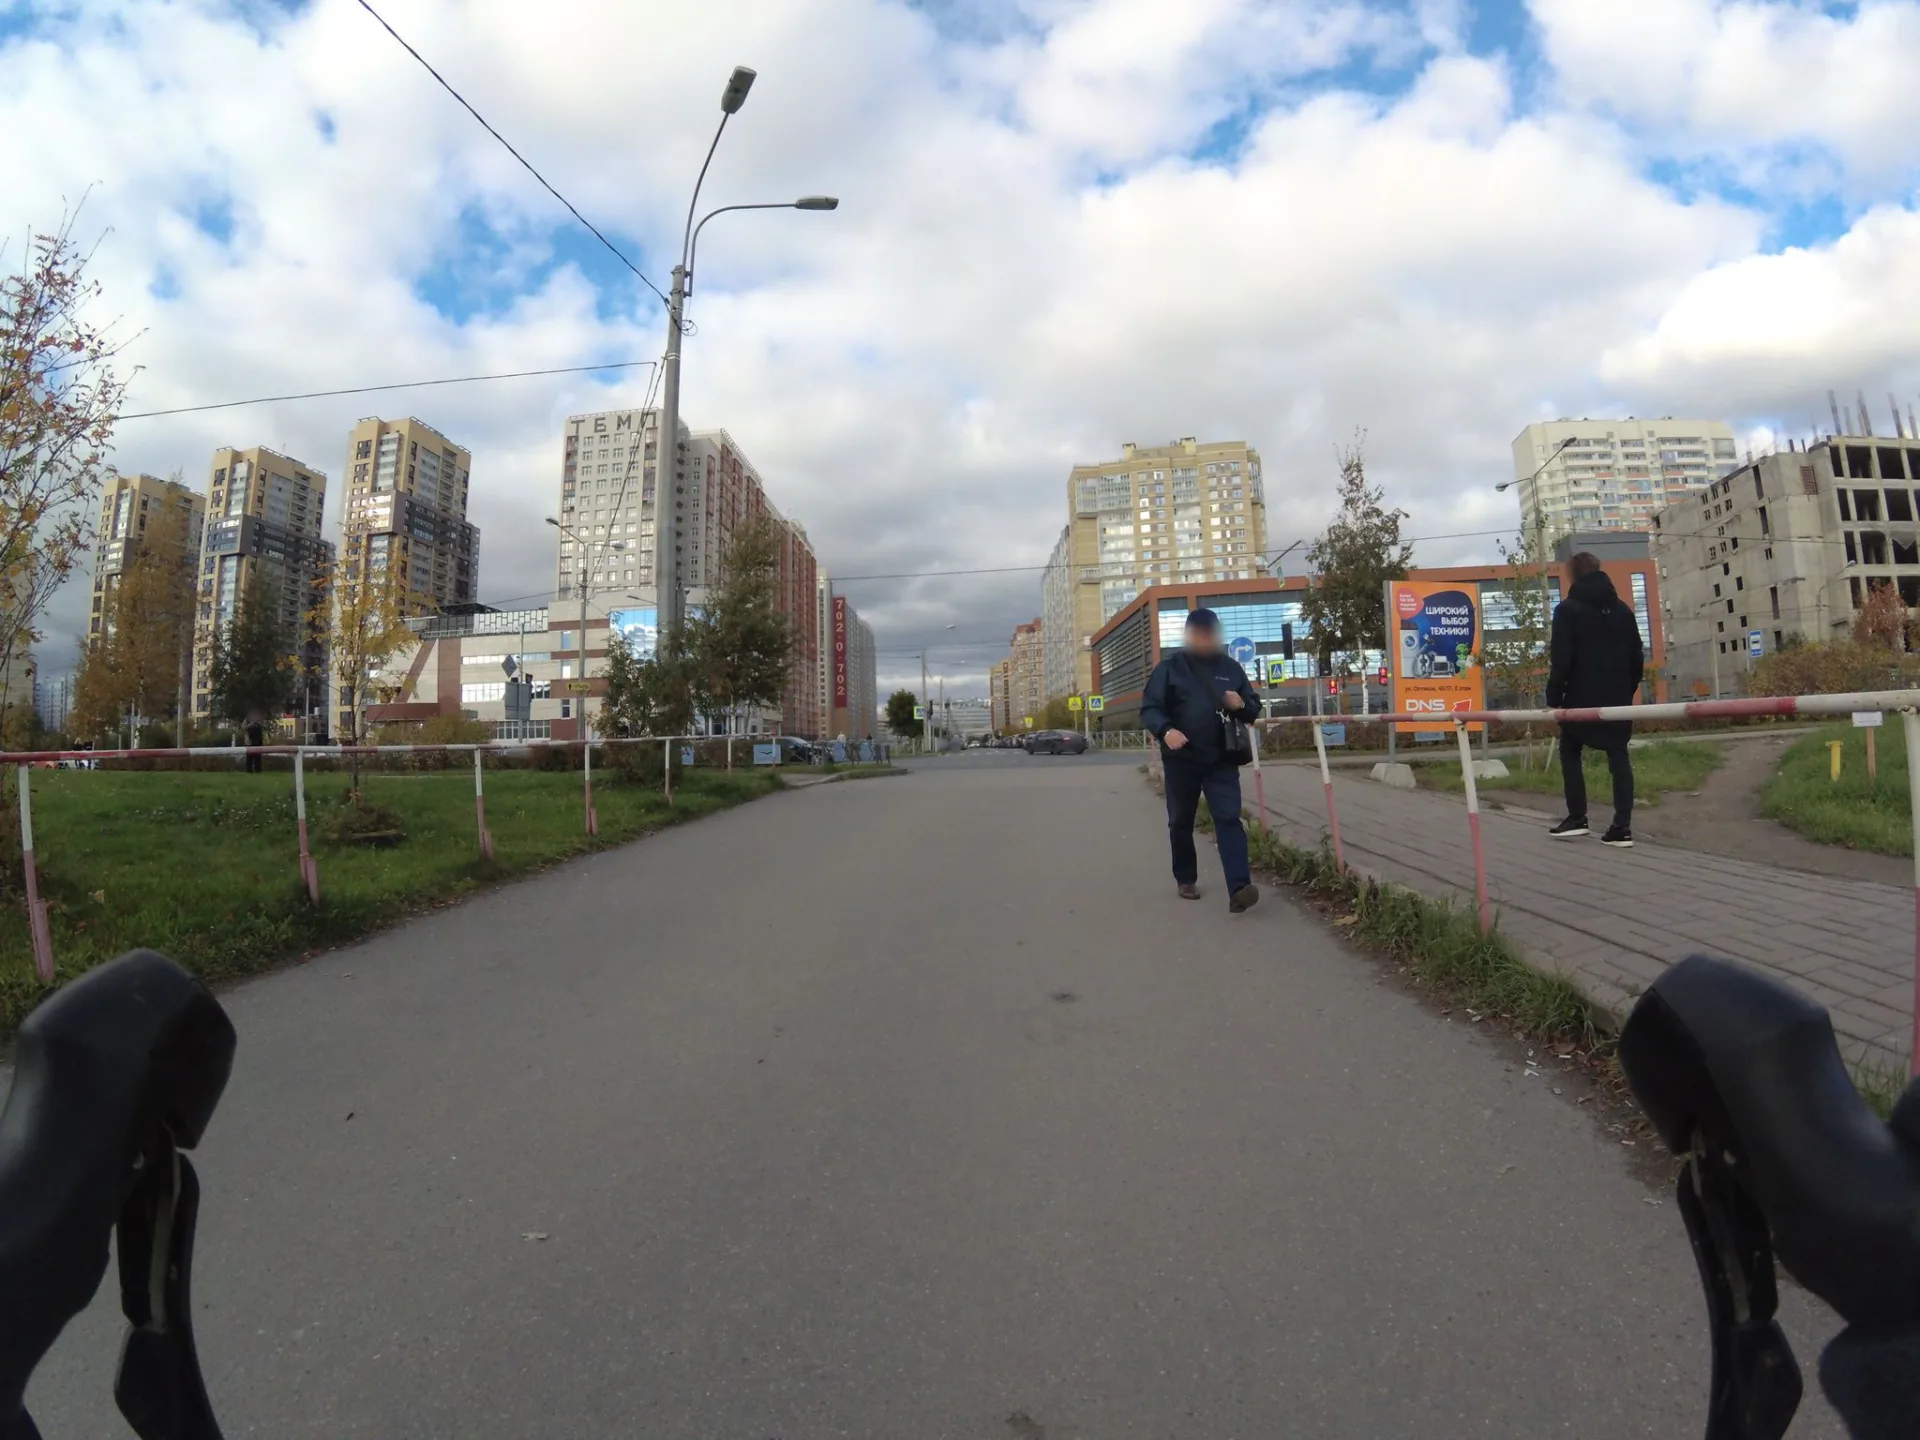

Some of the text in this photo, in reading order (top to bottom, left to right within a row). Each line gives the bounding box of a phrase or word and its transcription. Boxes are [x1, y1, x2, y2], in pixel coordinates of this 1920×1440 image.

[571, 412, 656, 434] ТЕМП
[1426, 606, 1468, 615] ШИРОКИЙ
[1441, 617, 1469, 625] ВЫБОР
[1430, 627, 1469, 636] ТЕХНИКИ!
[1406, 699, 1445, 711] DNS
